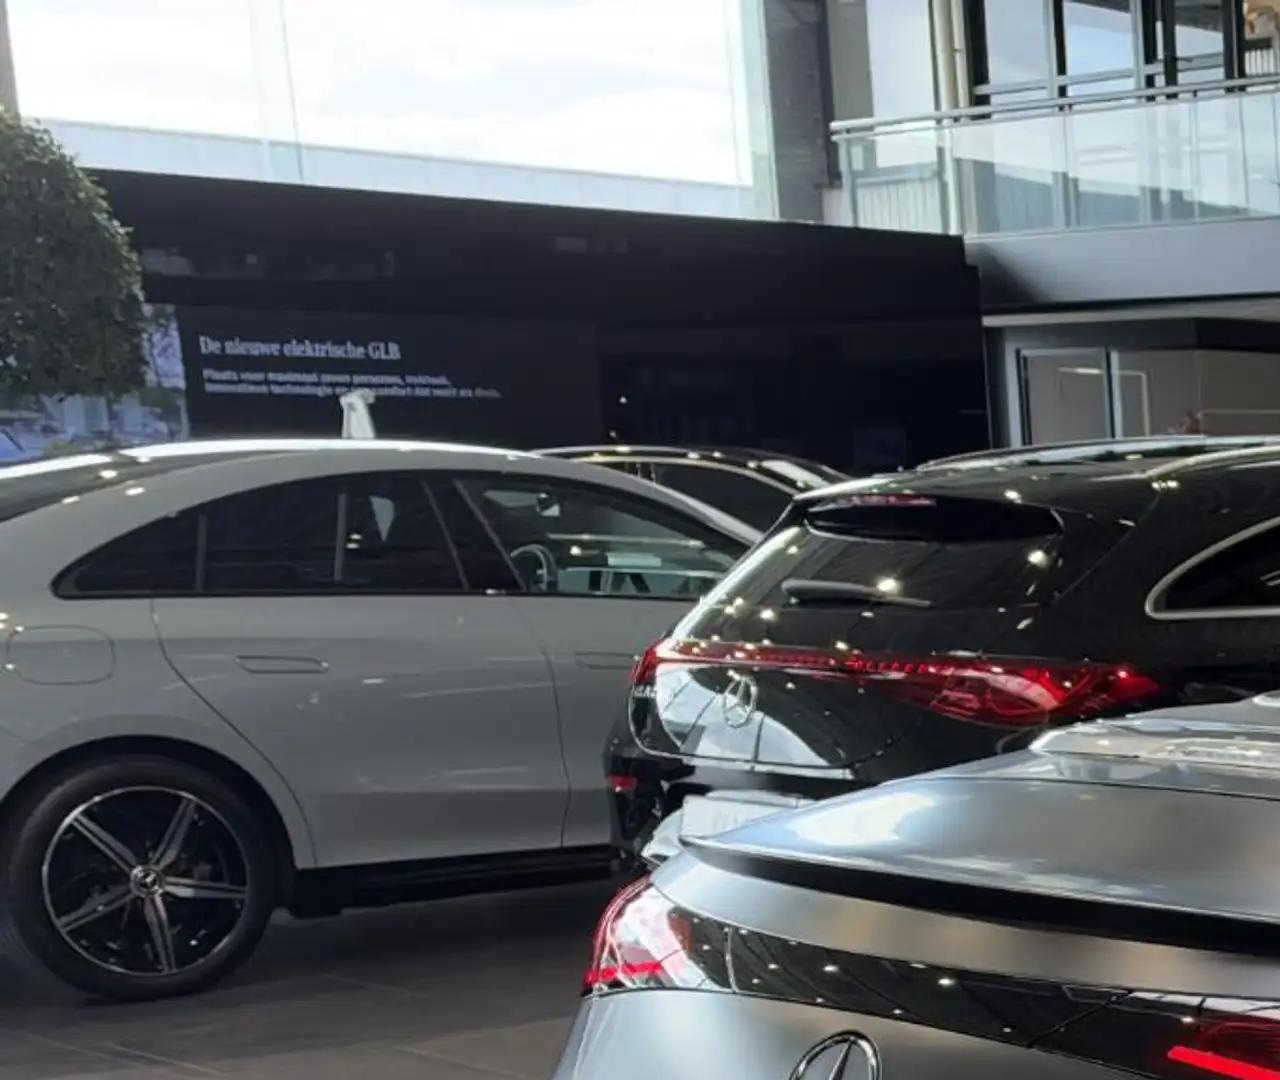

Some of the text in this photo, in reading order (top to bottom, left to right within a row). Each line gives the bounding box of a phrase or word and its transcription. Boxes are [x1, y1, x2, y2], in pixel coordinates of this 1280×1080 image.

[199, 335, 402, 361] De nieuwe elektrische GLB
